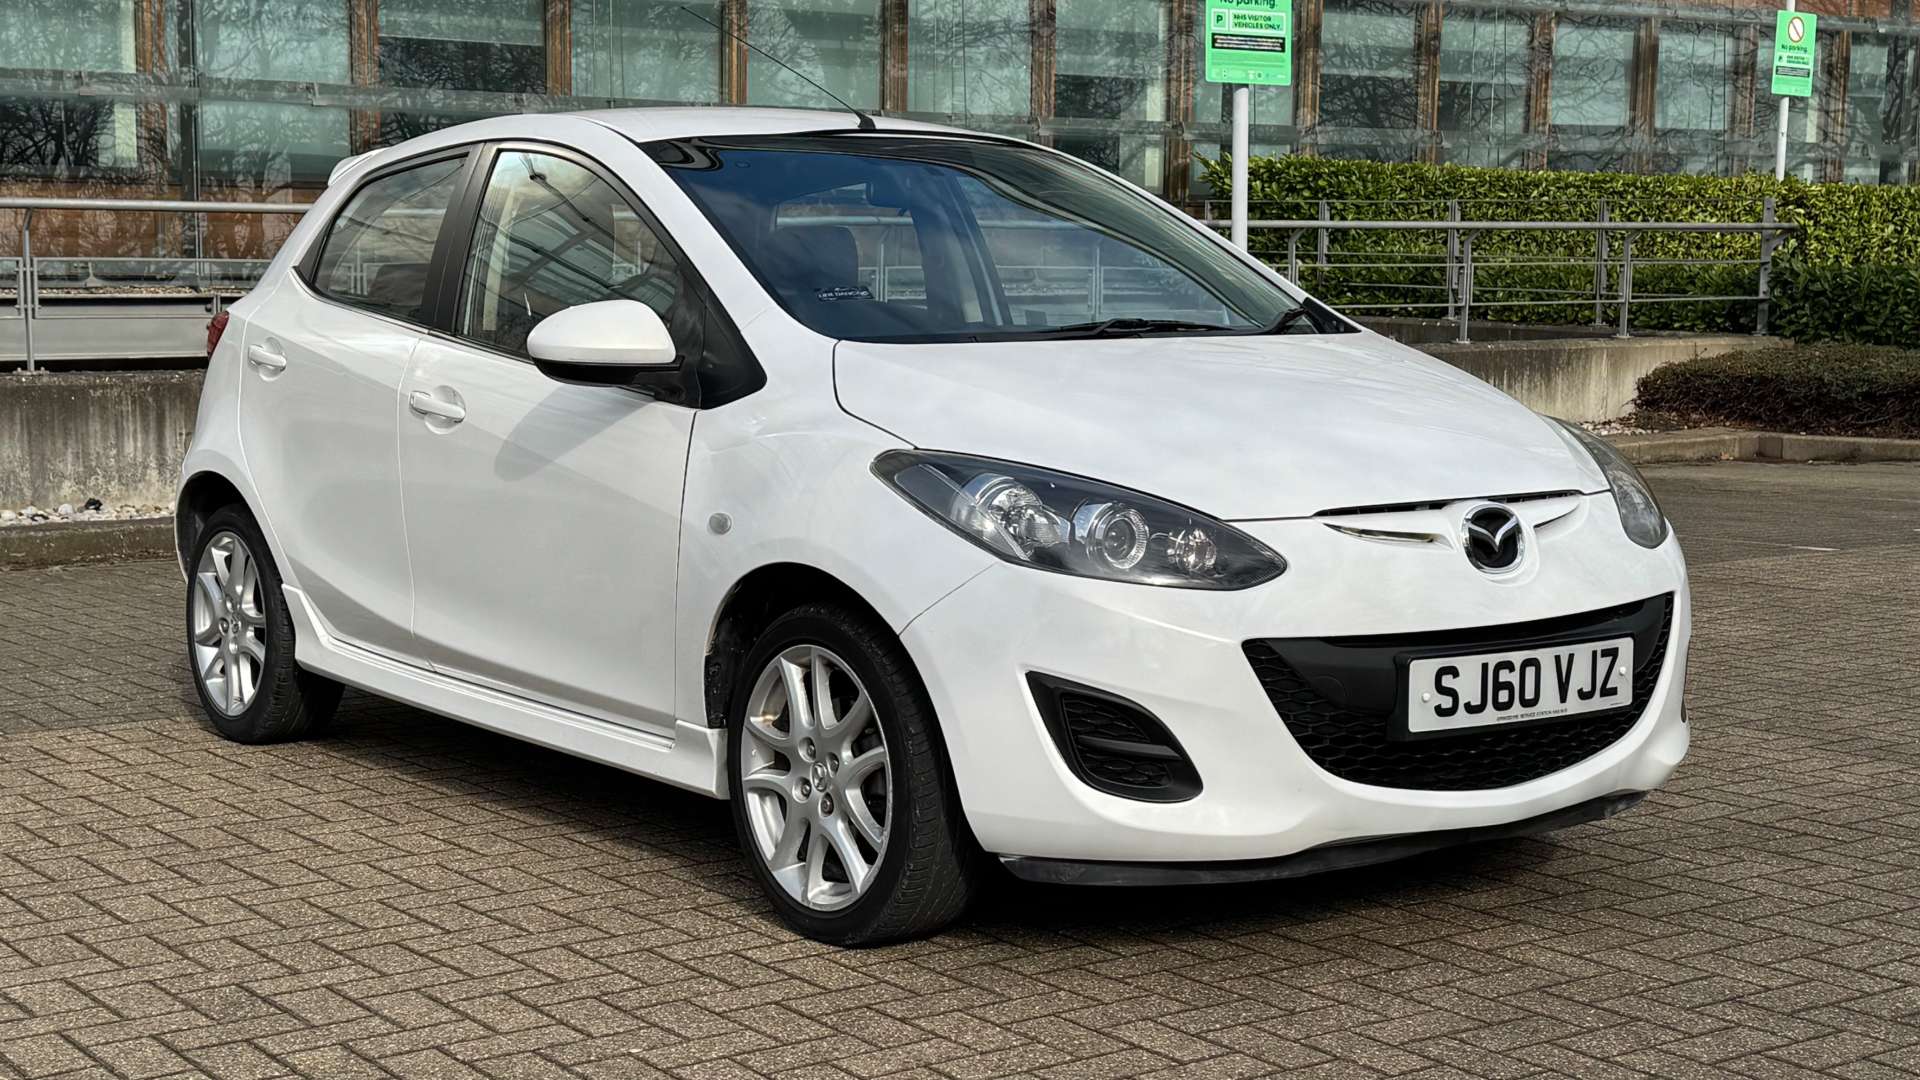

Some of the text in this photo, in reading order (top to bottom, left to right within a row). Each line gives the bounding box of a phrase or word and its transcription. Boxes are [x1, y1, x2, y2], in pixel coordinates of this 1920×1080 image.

[1216, 14, 1224, 25] P
[1248, 14, 1272, 22] VISITOR
[1233, 21, 1264, 29] VEHICLES
[1434, 647, 1619, 717] SJ60 VJZ
